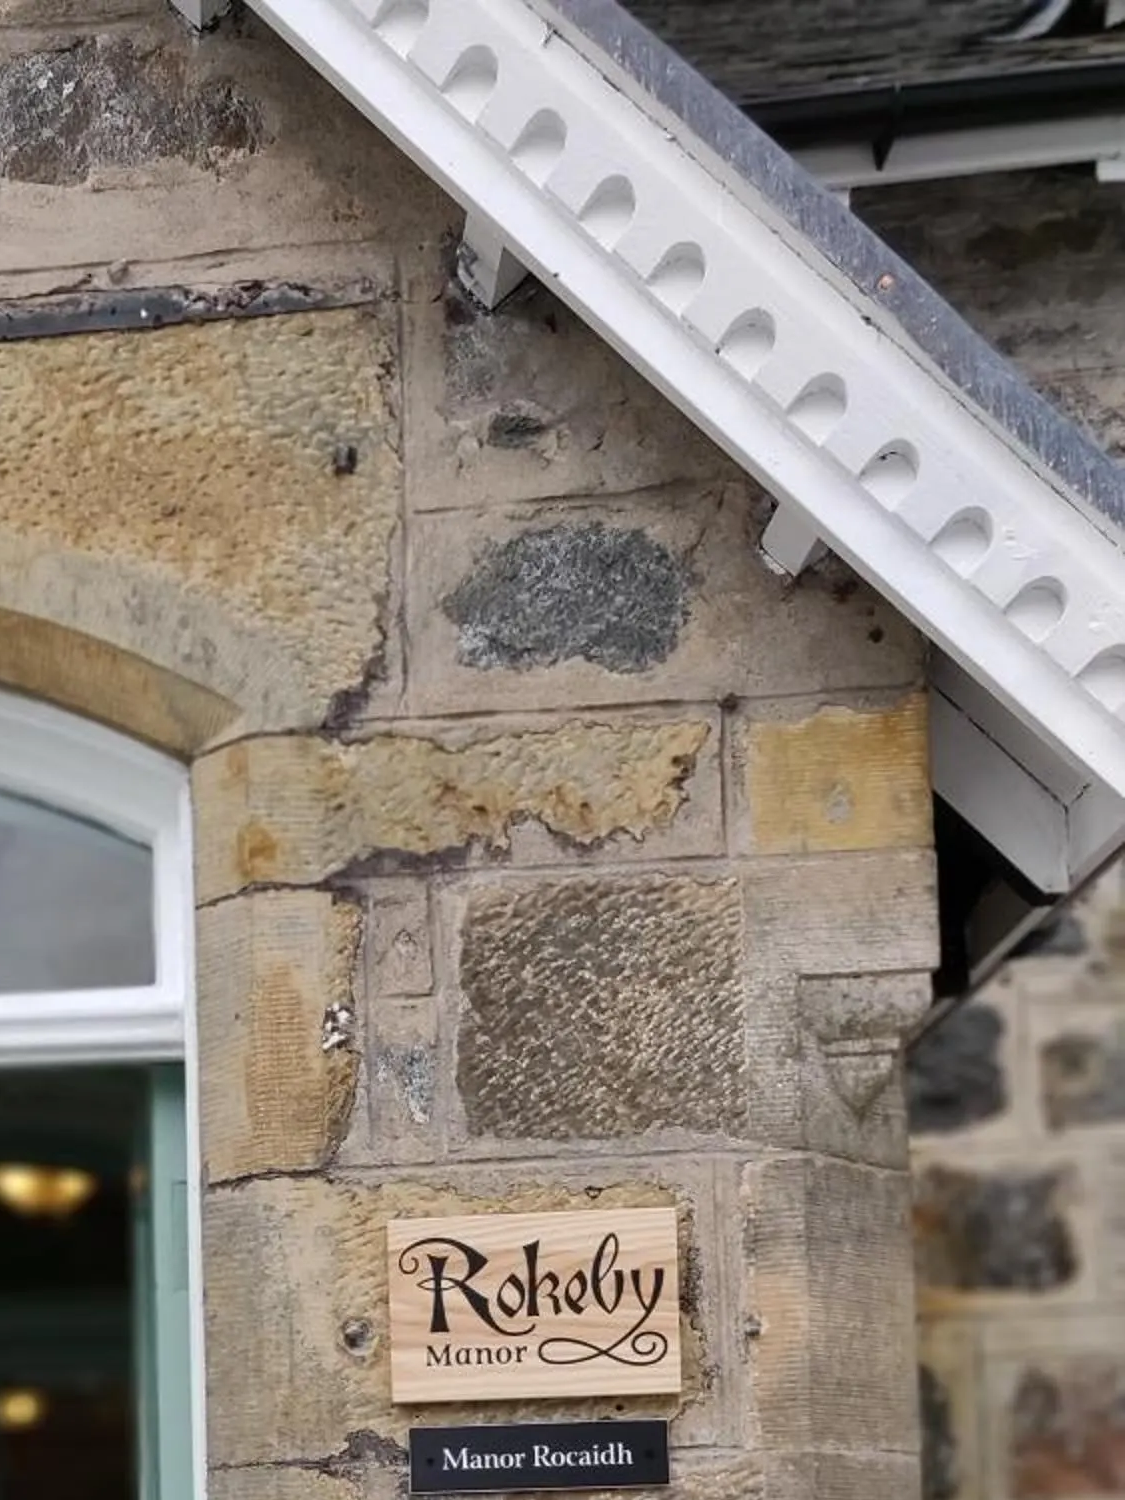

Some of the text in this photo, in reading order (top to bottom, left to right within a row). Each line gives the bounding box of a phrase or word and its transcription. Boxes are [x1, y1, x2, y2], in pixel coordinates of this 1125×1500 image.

[398, 1232, 668, 1367] Rokeby
[426, 1344, 528, 1367] Manor
[442, 1442, 634, 1470] Manor Rocaidh
